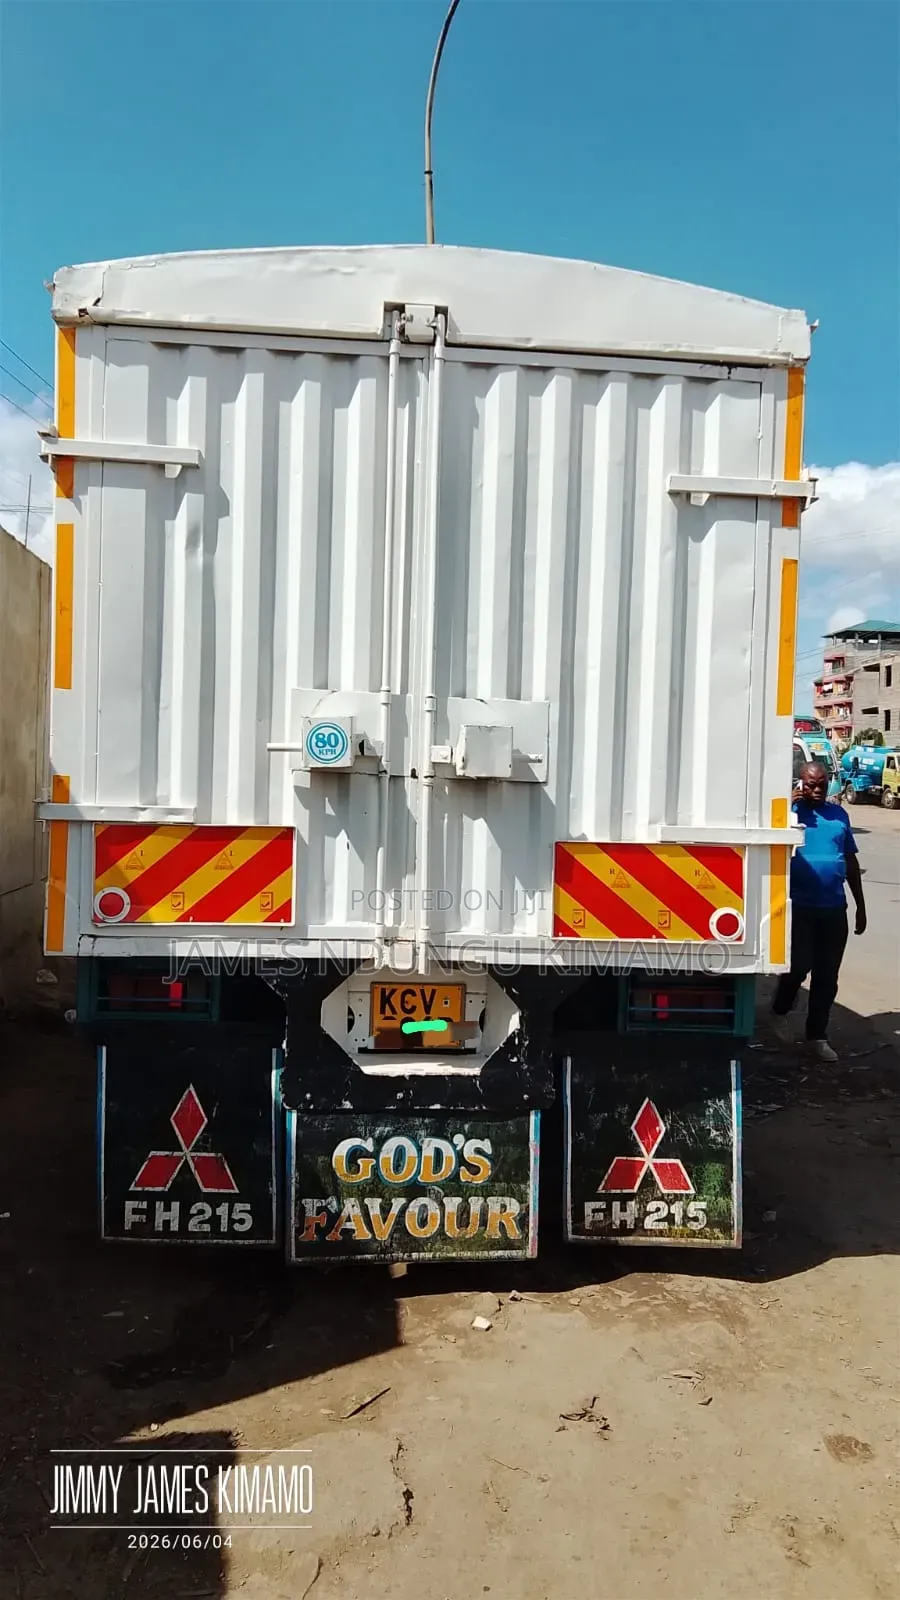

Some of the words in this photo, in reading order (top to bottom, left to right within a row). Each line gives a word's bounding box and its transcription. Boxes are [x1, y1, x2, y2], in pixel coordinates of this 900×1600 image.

[315, 733, 339, 748] 80
[380, 987, 437, 1015] KCV
[331, 1133, 493, 1185] GOD'S
[124, 1200, 180, 1232] FH
[187, 1201, 253, 1232] 215
[299, 1196, 522, 1242] FAVOUR
[584, 1200, 638, 1230] FH
[643, 1200, 708, 1230] 215
